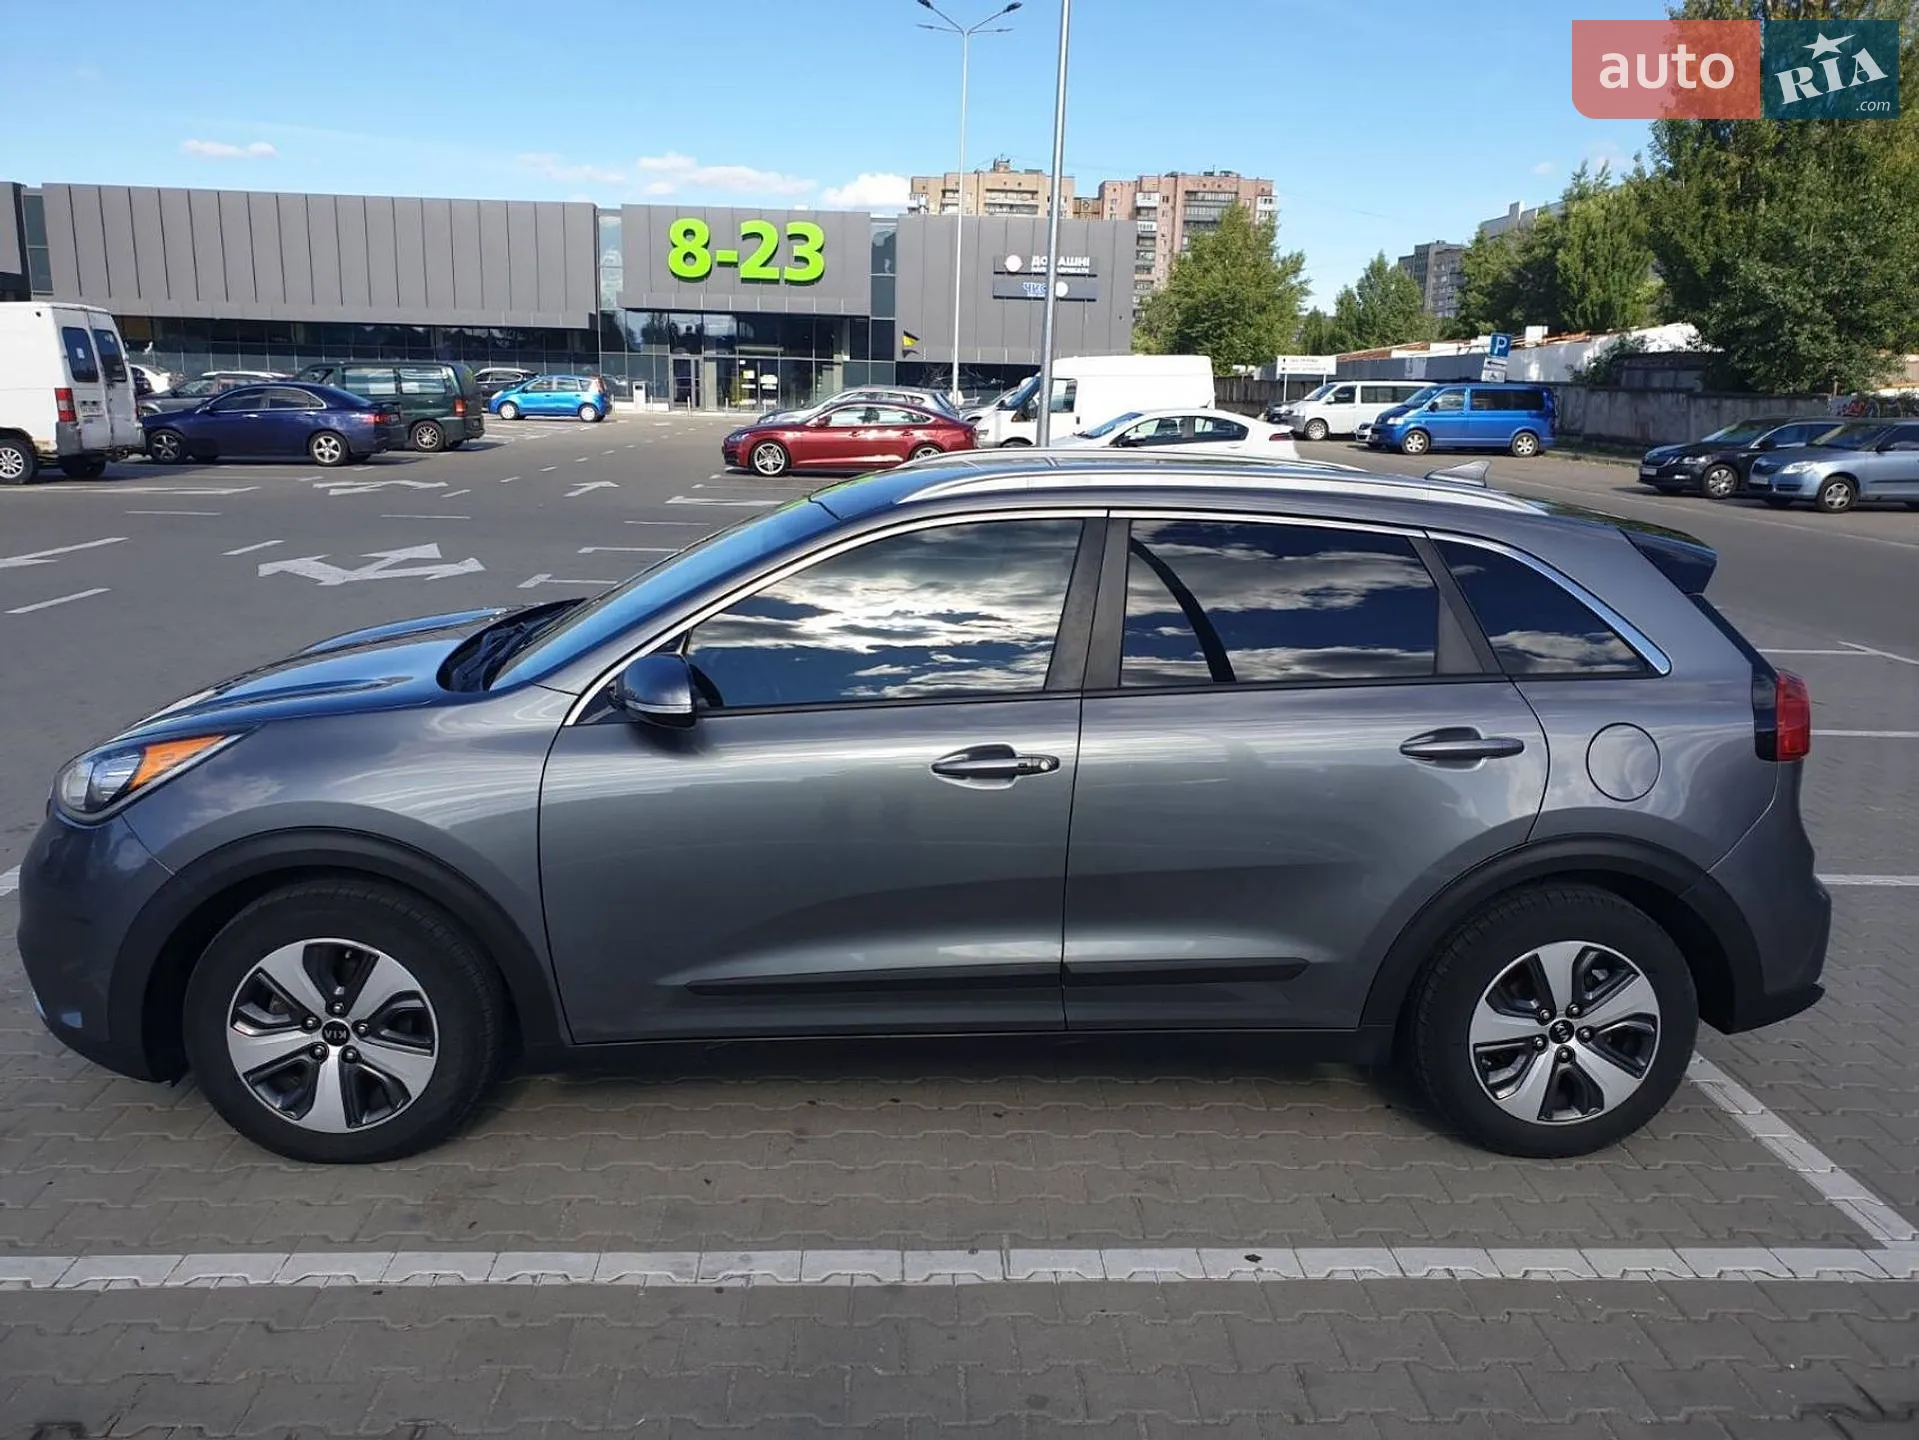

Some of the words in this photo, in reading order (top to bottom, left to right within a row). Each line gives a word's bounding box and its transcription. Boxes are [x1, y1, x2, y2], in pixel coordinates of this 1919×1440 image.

[668, 217, 825, 283] 8-23
[1031, 255, 1090, 267] ДОАШНІ
[1494, 336, 1508, 355] P
